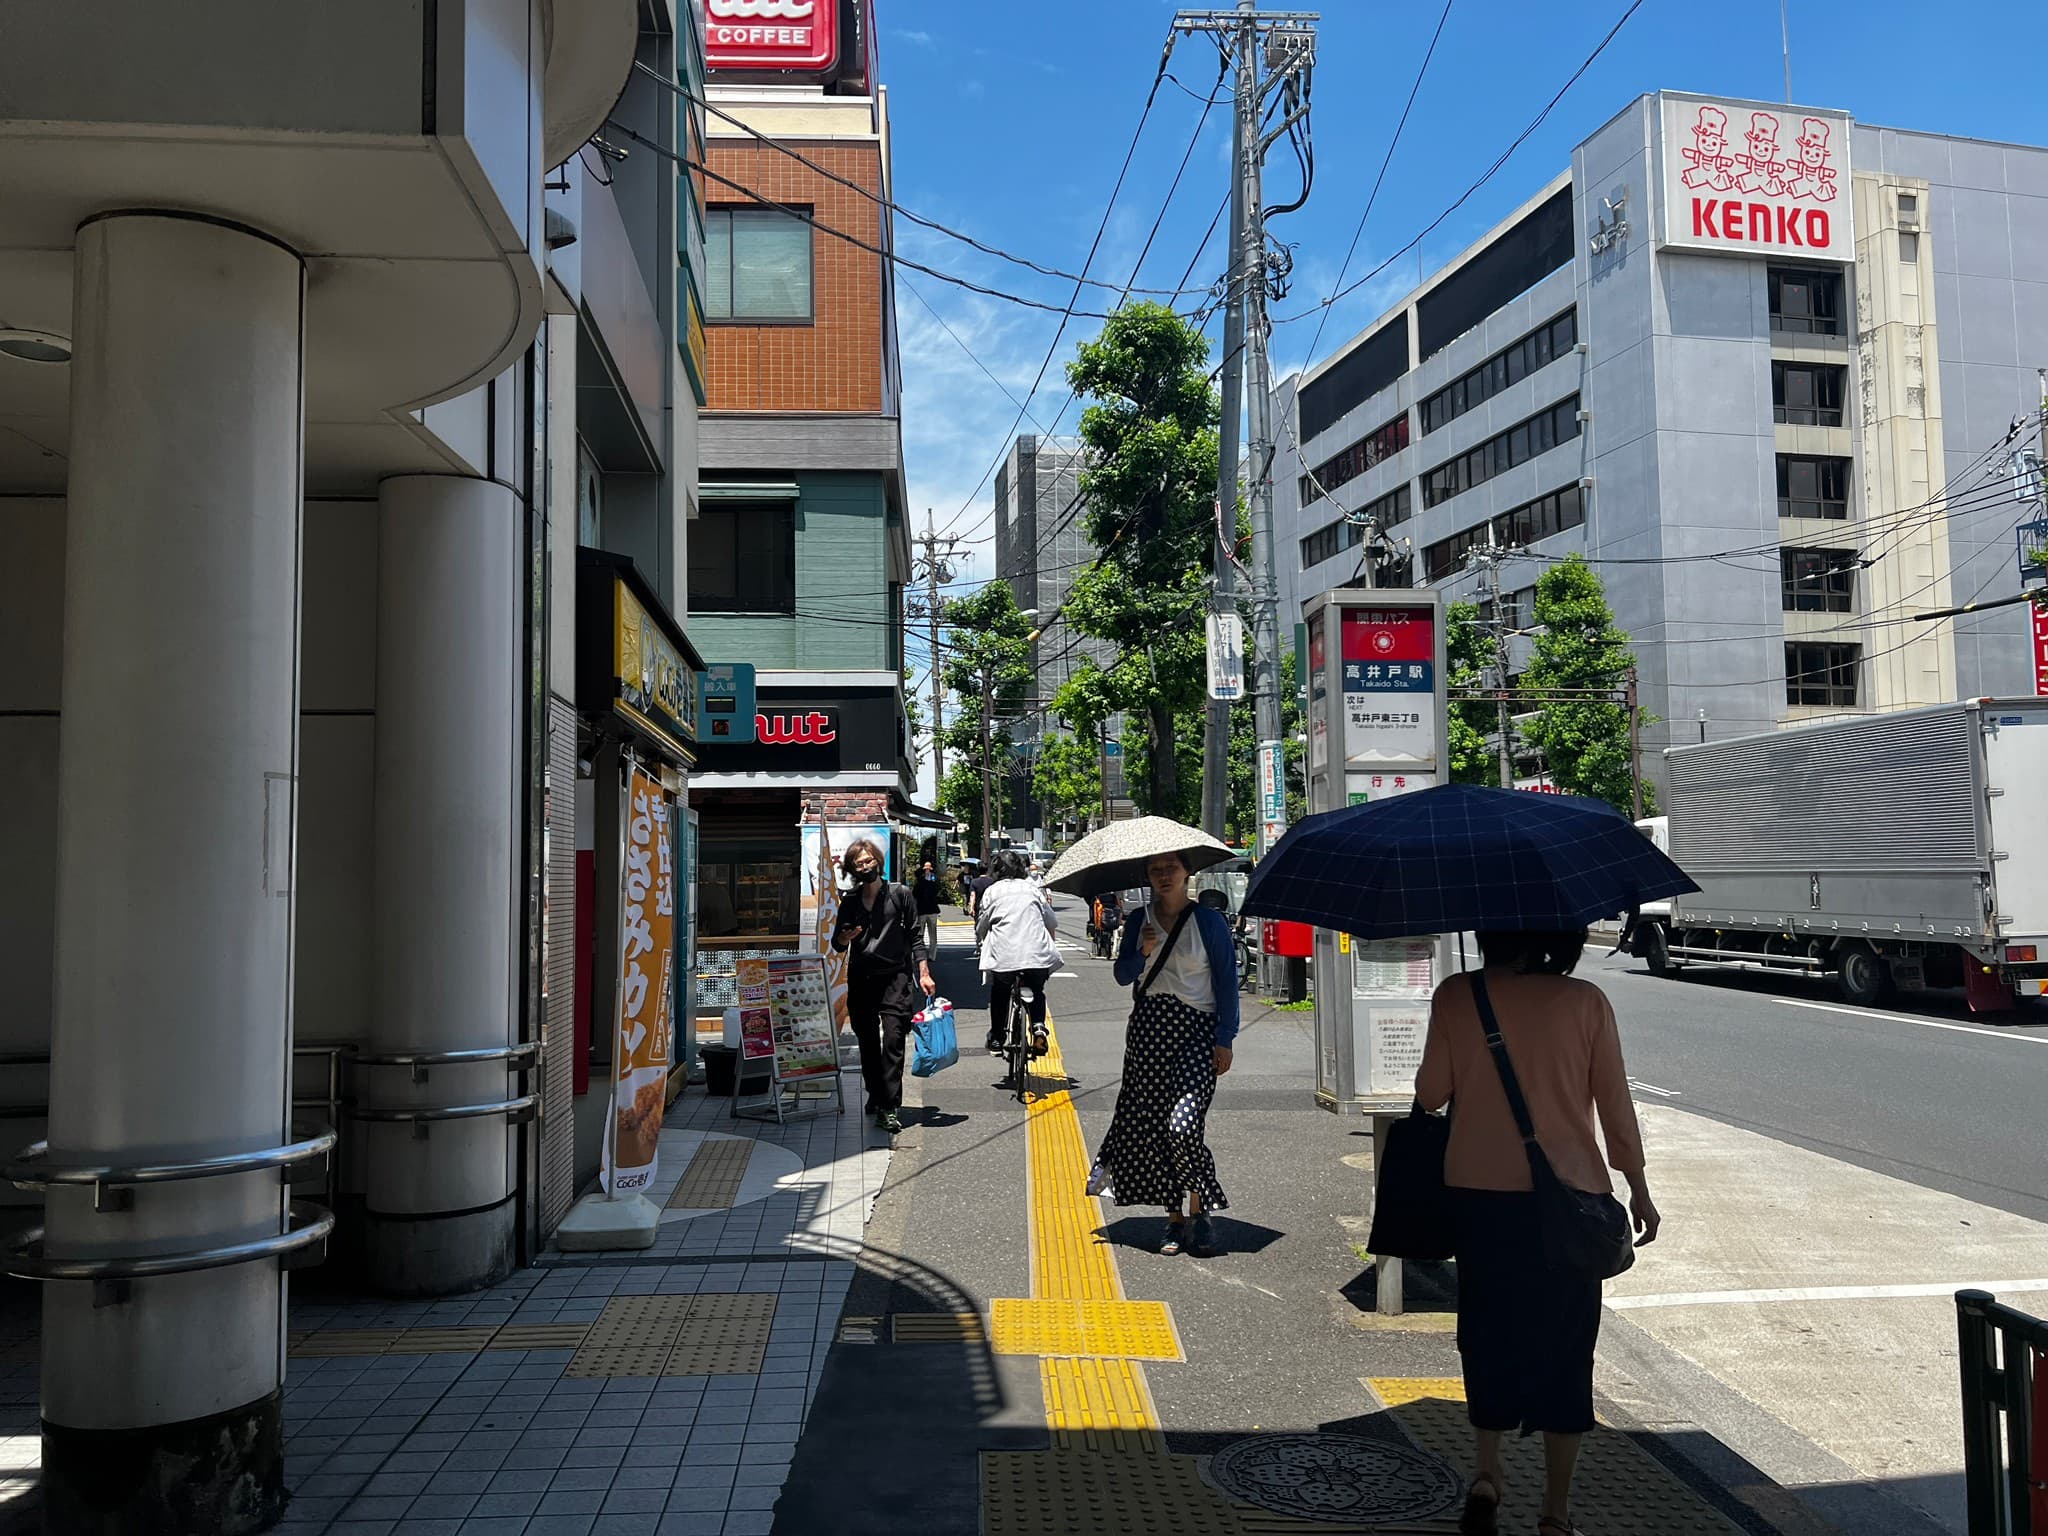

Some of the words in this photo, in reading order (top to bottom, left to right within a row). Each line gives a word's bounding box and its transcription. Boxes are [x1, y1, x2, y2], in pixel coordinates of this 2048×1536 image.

[717, 28, 806, 44] COFFEE
[1692, 198, 1829, 248] KENKO
[1356, 612, 1410, 624] 関東バス
[1346, 665, 1424, 679] 高井戸駅
[1360, 679, 1391, 688] Takaido
[1394, 680, 1410, 688] Sta.
[1346, 695, 1365, 705] 次は
[1352, 713, 1419, 723] 高井戸東三丁目
[1371, 776, 1406, 788] 行先
[621, 788, 652, 1073] ささみカツ
